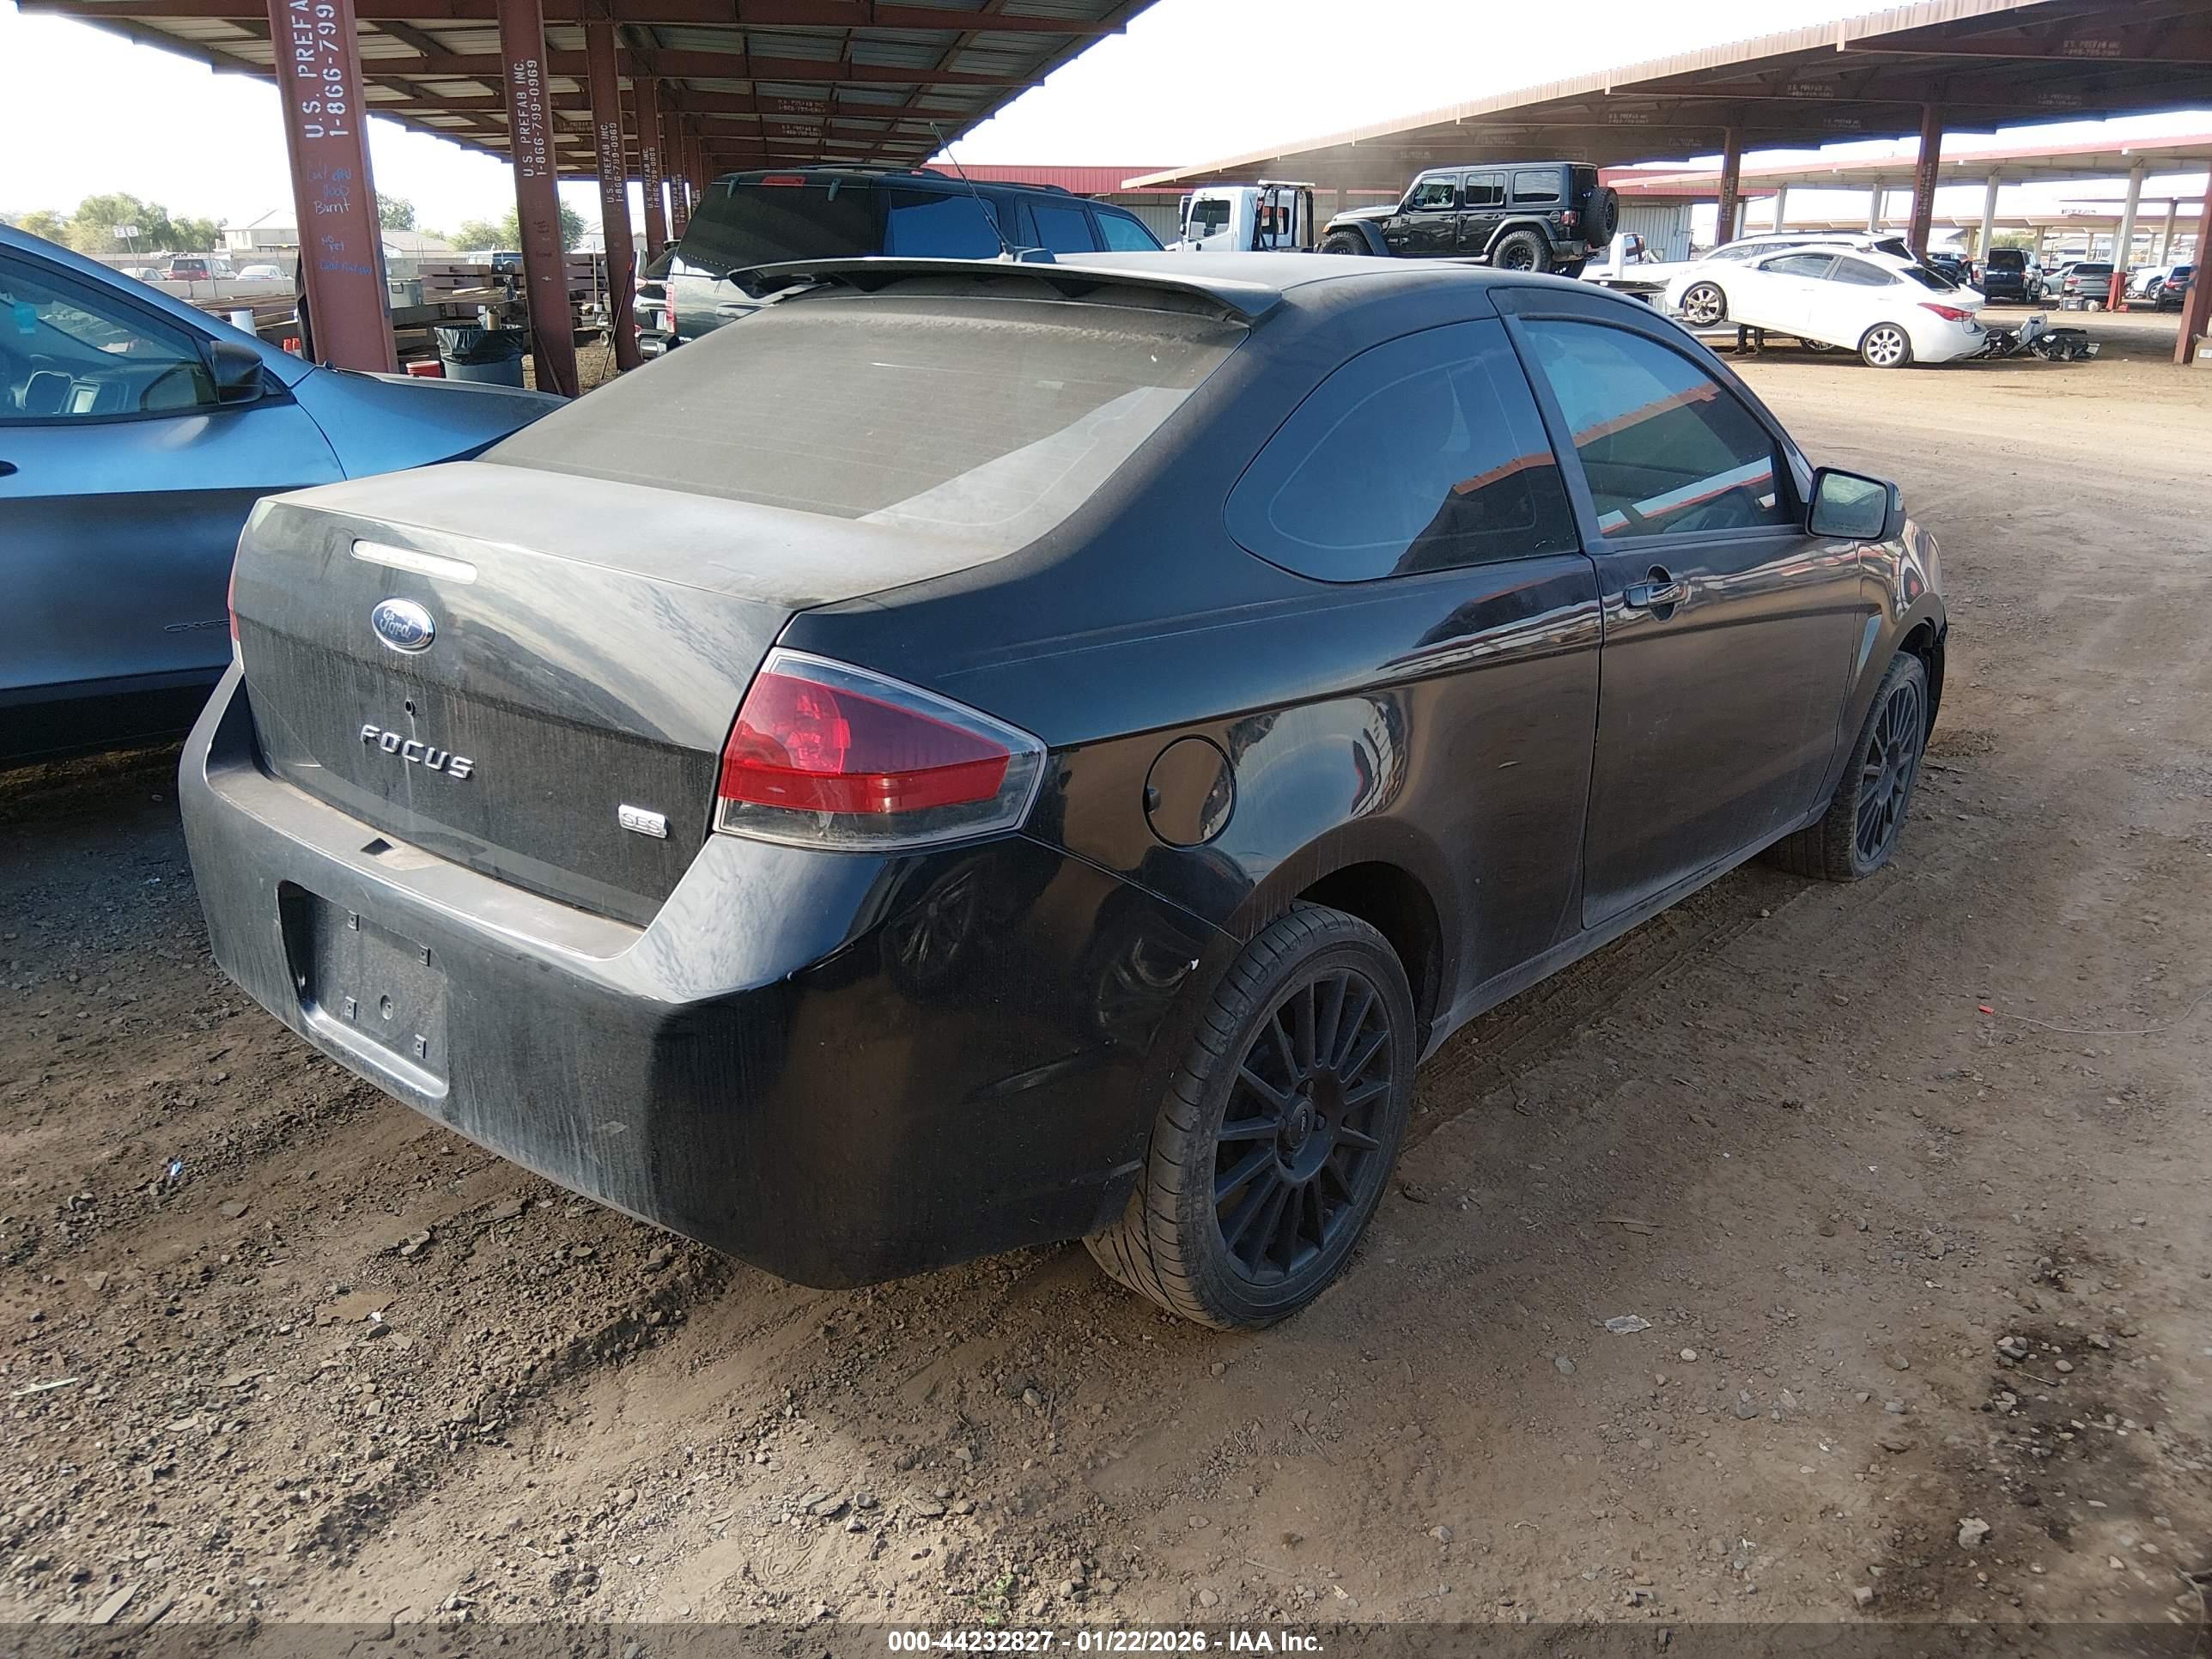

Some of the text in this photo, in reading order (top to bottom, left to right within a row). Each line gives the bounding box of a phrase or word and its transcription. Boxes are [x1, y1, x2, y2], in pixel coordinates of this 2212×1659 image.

[301, 93, 325, 138] U.S.
[514, 58, 534, 177] U.S. PREFAB INC.
[526, 59, 549, 176] 1-866-799-0969
[601, 144, 613, 180] PREFAB
[379, 606, 414, 639] Ford
[360, 724, 476, 779] FOCUS
[623, 812, 661, 833] SES
